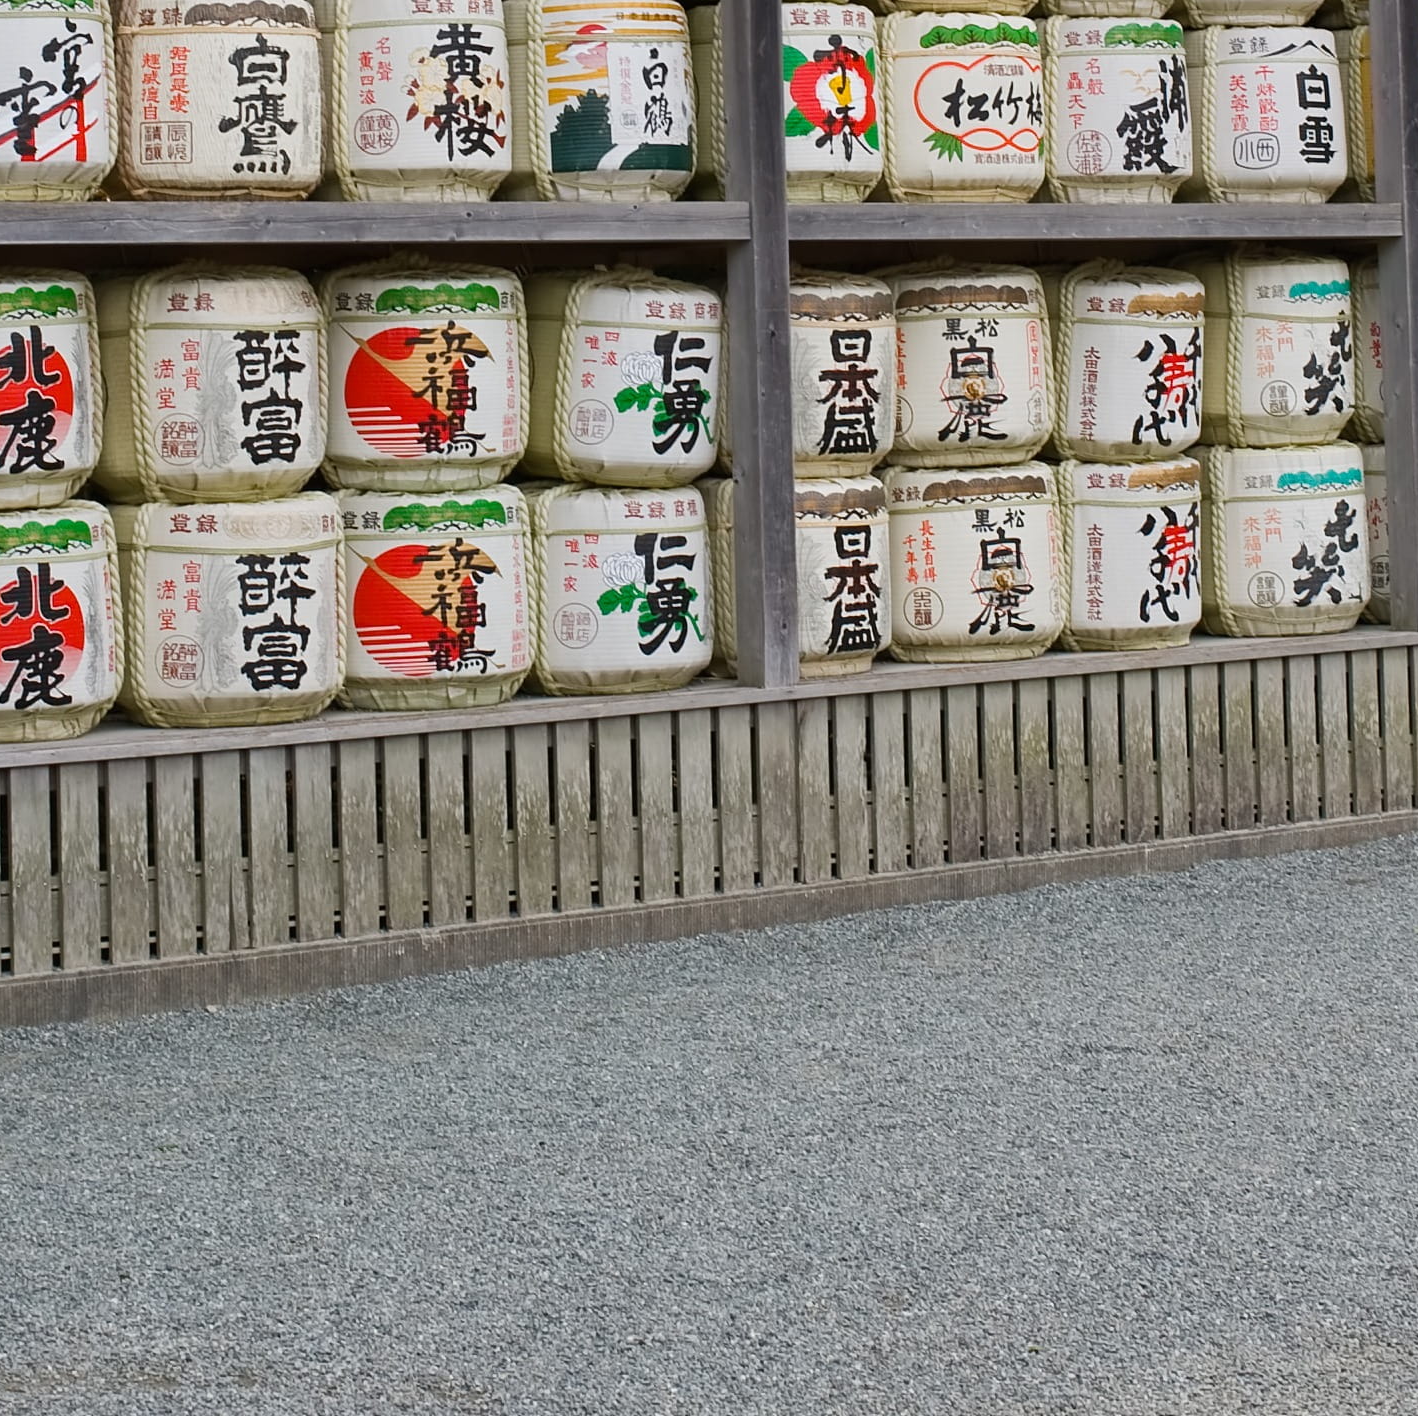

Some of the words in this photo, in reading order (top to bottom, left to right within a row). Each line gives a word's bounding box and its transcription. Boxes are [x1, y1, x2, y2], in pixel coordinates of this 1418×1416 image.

[219, 34, 297, 175] 白鷹
[431, 23, 493, 162] 黄桜
[643, 48, 673, 138] 白鶴
[1296, 64, 1337, 163] 白雪
[182, 339, 201, 391] 富貴
[404, 320, 496, 456] 浜福鶴
[938, 336, 1007, 442] 白鹿
[943, 318, 998, 341] 黒松
[652, 331, 713, 455] 仁勇
[818, 329, 879, 455] 日本盛
[969, 528, 1035, 635] 白鹿
[972, 509, 1025, 532] 黒松
[414, 539, 505, 674] 浜福鶴
[639, 532, 697, 655] 仁勇
[824, 525, 881, 654] 日本盛
